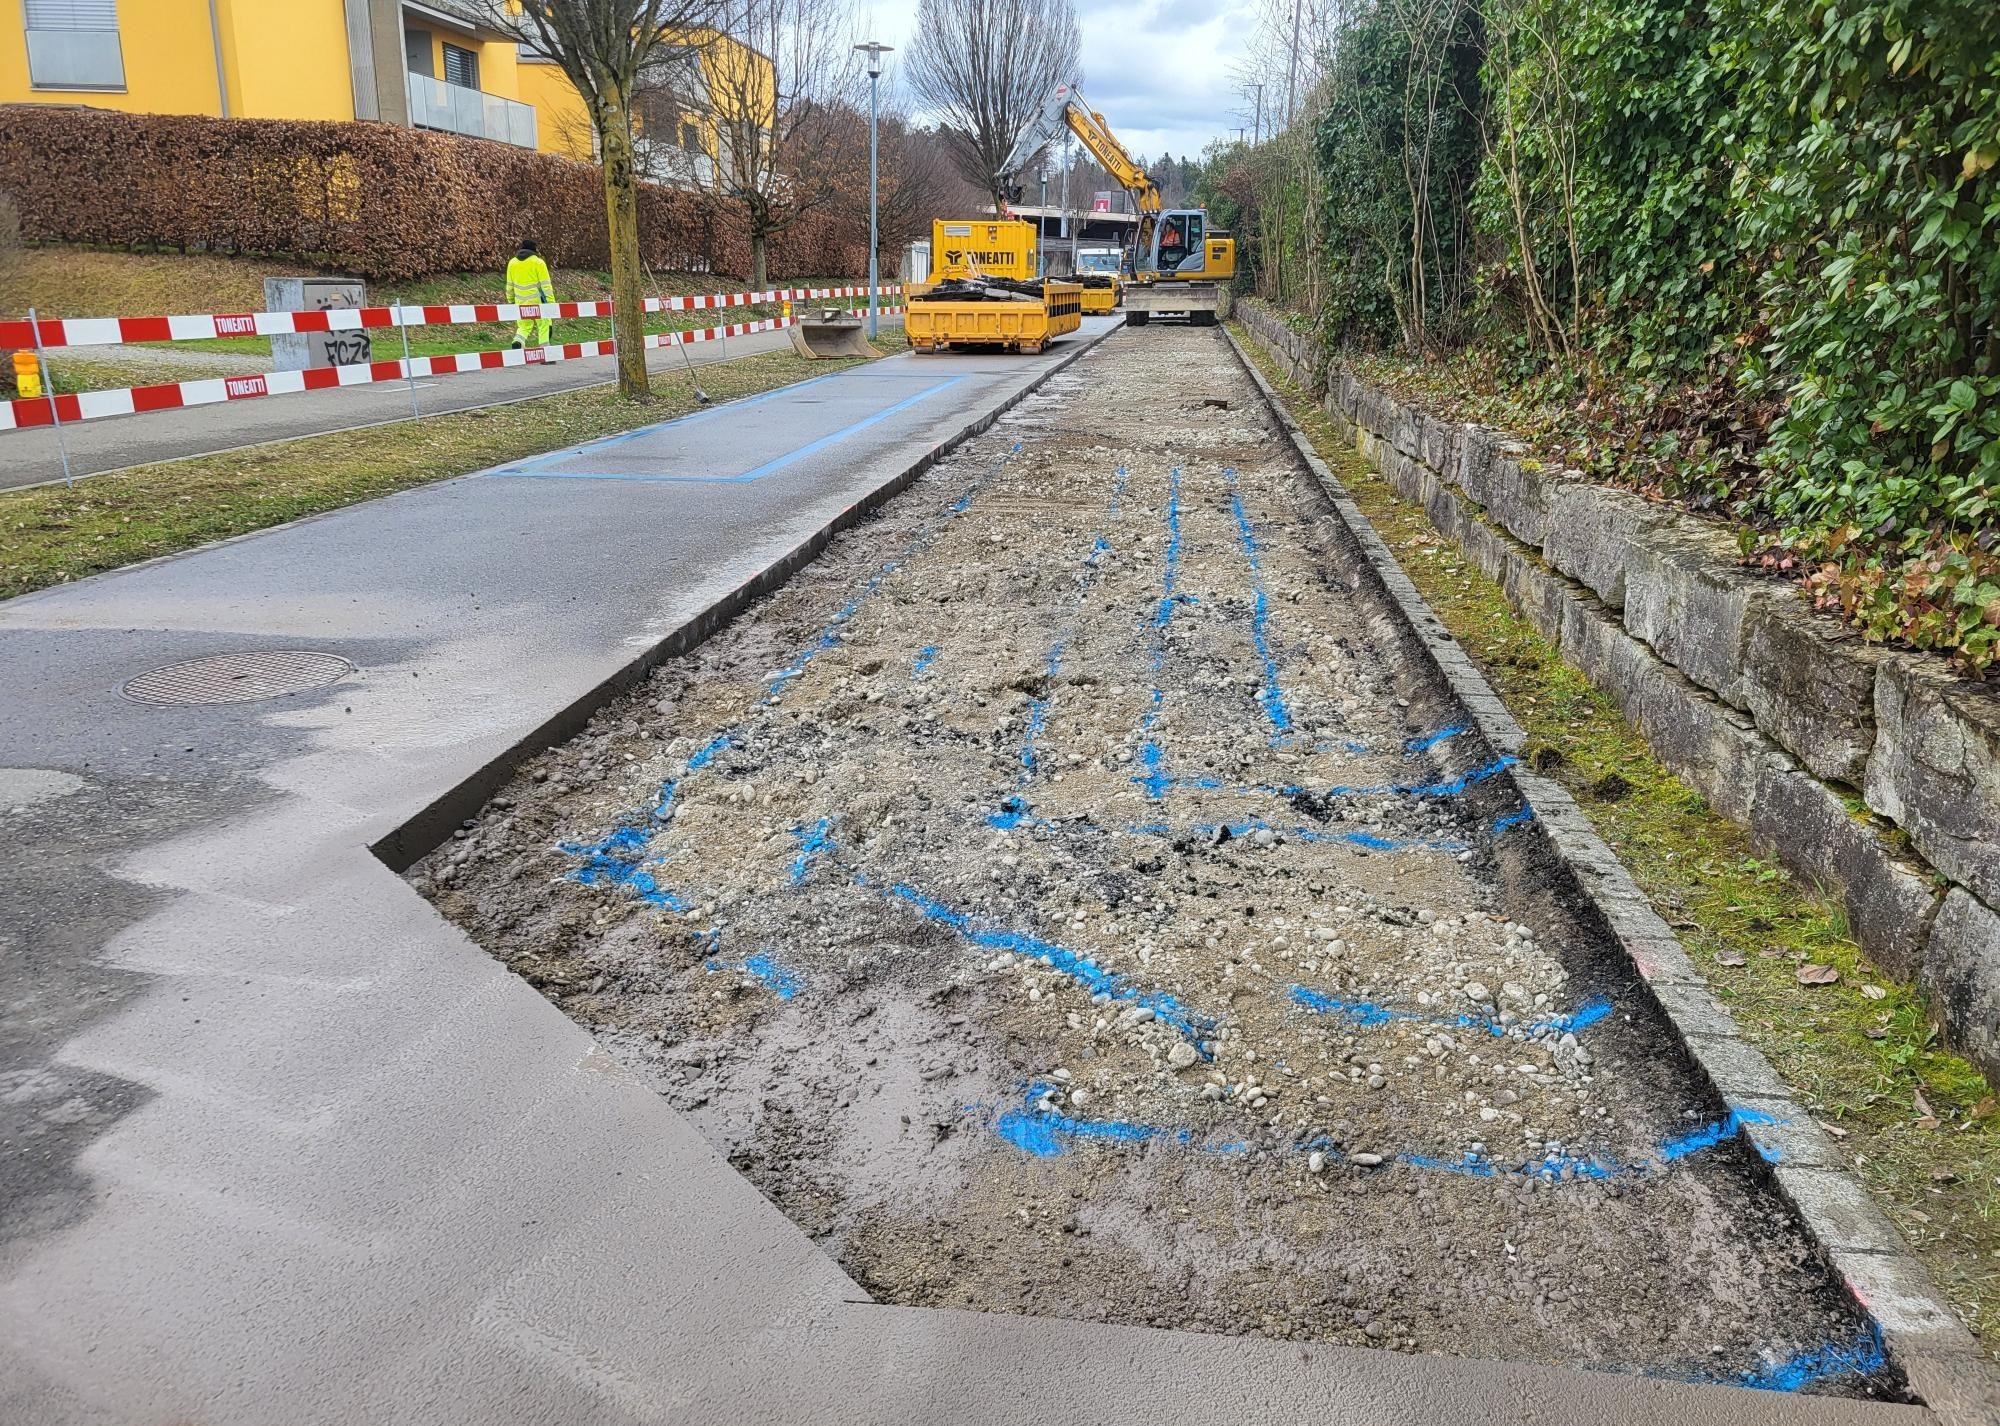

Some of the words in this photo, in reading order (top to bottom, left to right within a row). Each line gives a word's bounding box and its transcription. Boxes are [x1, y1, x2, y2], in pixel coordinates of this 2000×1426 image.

[1096, 140, 1121, 172] TONEATTI
[215, 316, 255, 334] TONEATTI
[227, 378, 266, 396] TONEATTI
